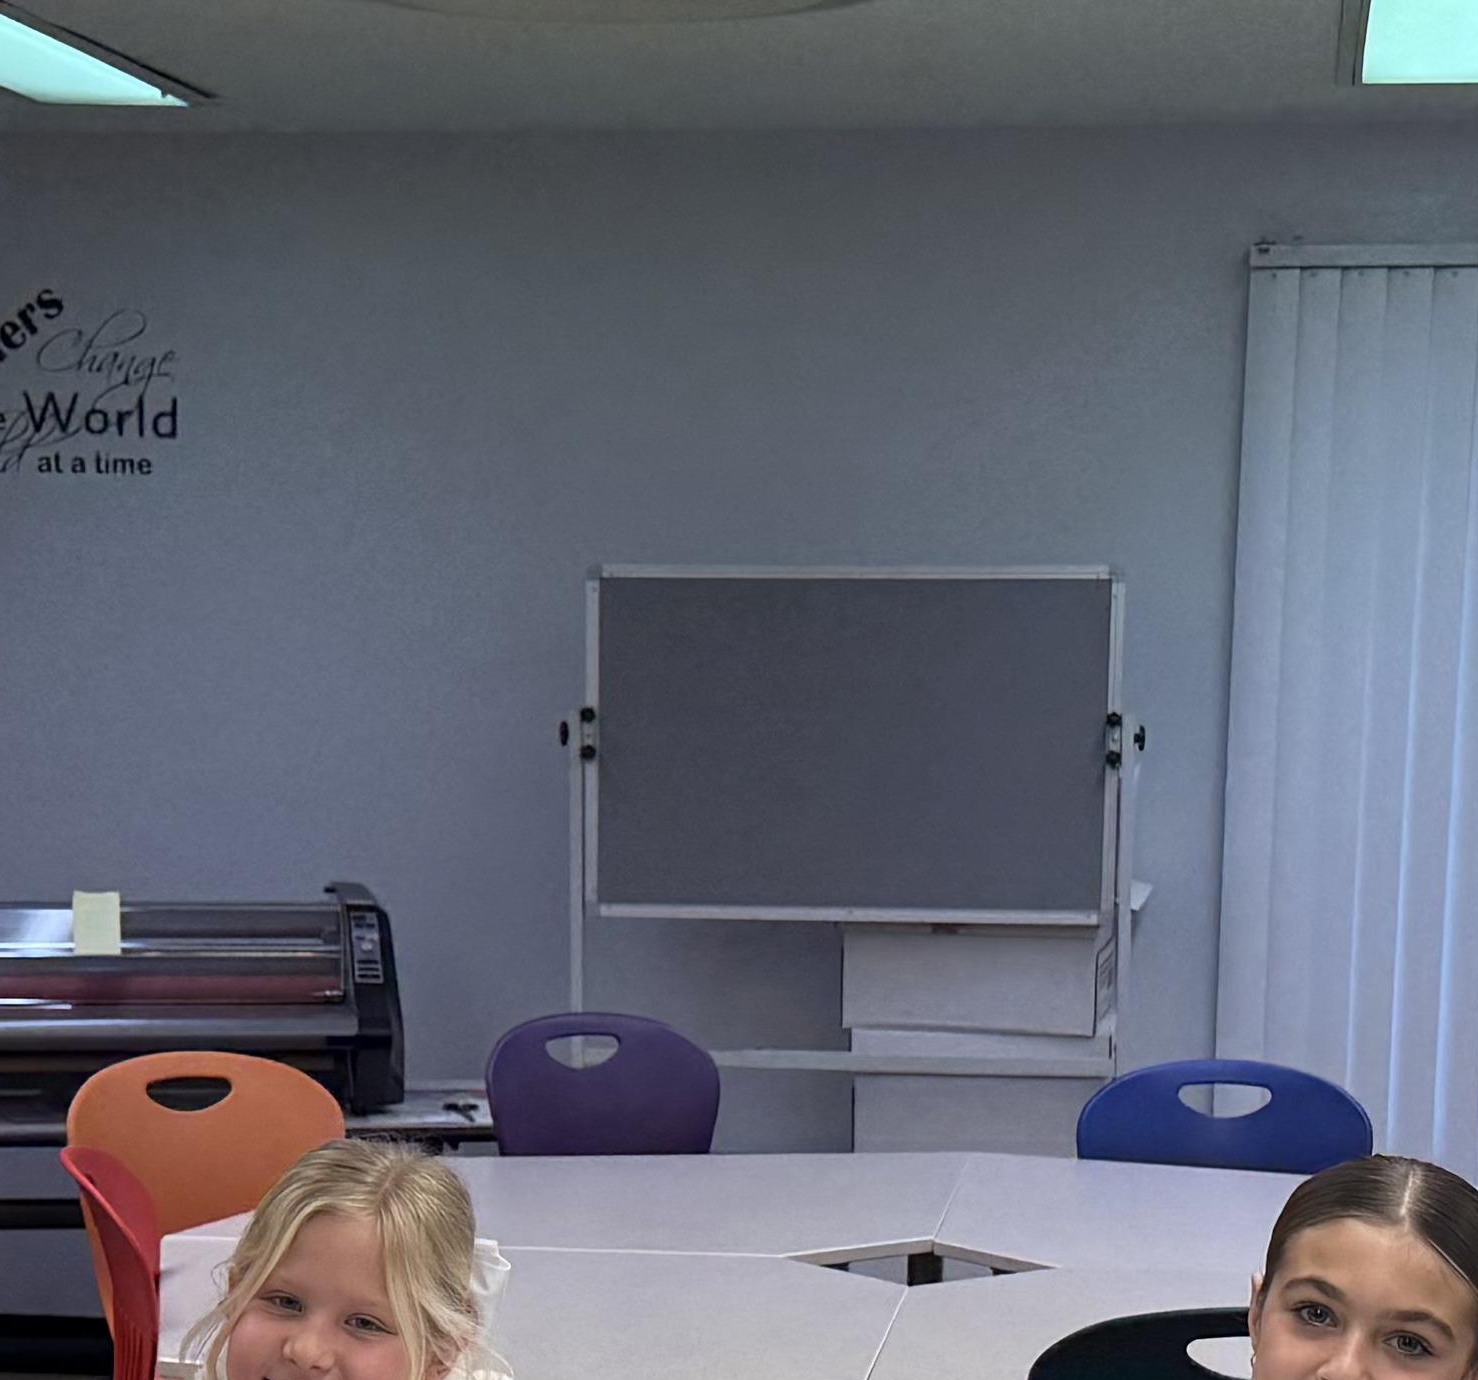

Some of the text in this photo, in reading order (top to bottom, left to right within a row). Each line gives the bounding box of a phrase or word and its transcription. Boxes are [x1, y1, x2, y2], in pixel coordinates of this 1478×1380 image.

[36, 310, 177, 404] Change
[22, 390, 178, 440] World
[37, 450, 63, 474] at
[71, 456, 87, 474] a
[95, 452, 153, 475] time
